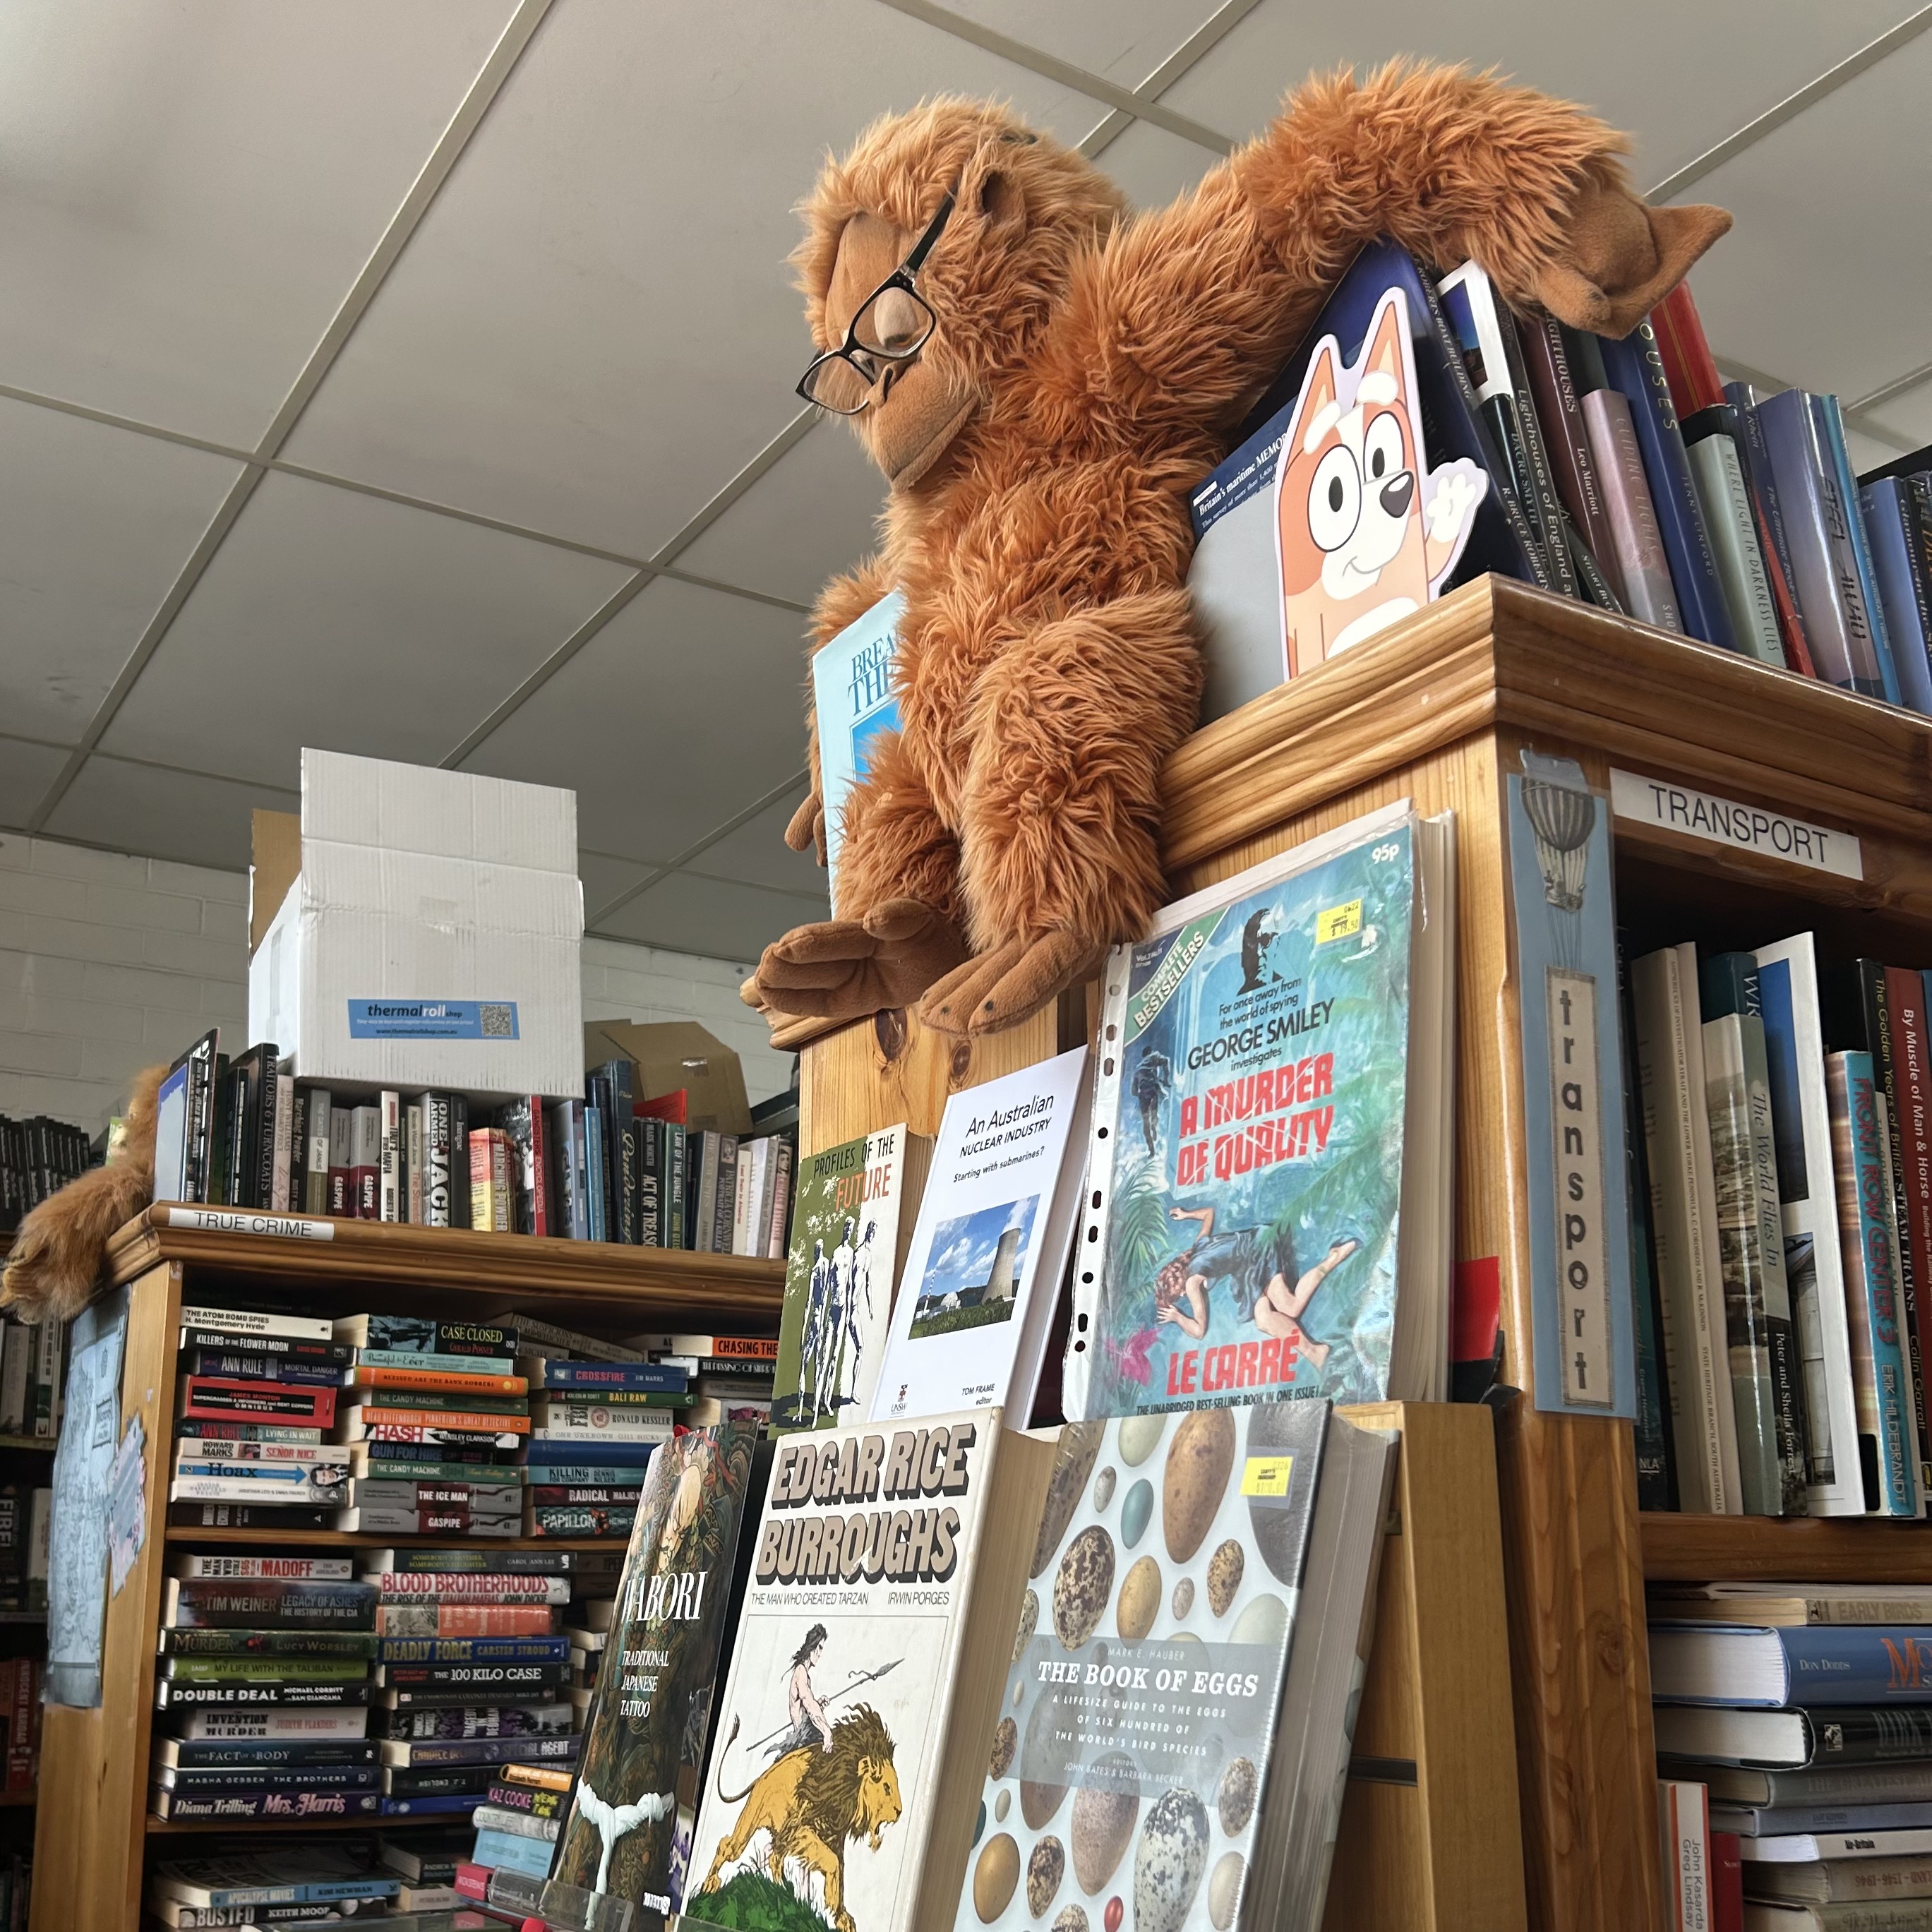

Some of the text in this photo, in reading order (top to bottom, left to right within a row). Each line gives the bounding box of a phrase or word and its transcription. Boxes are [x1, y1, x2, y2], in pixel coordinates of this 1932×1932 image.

[1199, 487, 1225, 516] Britain's
[1226, 463, 1255, 493] maritime
[1518, 389, 1571, 584] Lighthouses of England
[1726, 453, 1780, 652] WHERE LIGHT IN DARKNESS LIES
[852, 632, 898, 683] BREA
[1648, 784, 1829, 864] TRANSPORT
[1372, 843, 1400, 867] 95p
[1134, 930, 1204, 1029] BESTSELLERS
[1141, 941, 1184, 1000] COMPLETE
[368, 1004, 445, 1016] thermalroll
[1219, 978, 1302, 1017] For once away from
[1220, 994, 1299, 1031] the world of spying
[1187, 997, 1336, 1072] GEORGE SMILEY
[1230, 1046, 1282, 1072] investigates
[265, 1055, 276, 1108] TRAITORS
[1179, 1052, 1334, 1140] A MURDER
[966, 1093, 1055, 1138] An Australian
[1903, 1009, 1929, 1199] By Muscle of Man & Horse
[261, 1120, 274, 1192] TURNCOATS
[673, 1146, 682, 1156] OF
[959, 1117, 1052, 1158] NUCLEAR INDUSTRY
[1177, 1105, 1334, 1186] OF QUALITY
[1876, 979, 1916, 1312] The Golden Years of British STEAM TRAINS
[673, 1158, 682, 1175] THE
[814, 1133, 895, 1180] PROFILES OF THE
[954, 1146, 1045, 1184] Starting with submarines?
[673, 1175, 682, 1204] JUNGLE
[836, 1163, 892, 1212] FUTURE
[1559, 988, 1589, 1391] transport
[1752, 1093, 1778, 1268] The World Flies In
[194, 1212, 313, 1237] TRUE CRIME
[643, 1175, 657, 1248] ACT OF TREASO
[1853, 1076, 1895, 1343] FRONT ROW CENTER 3
[440, 1325, 503, 1343] CASE CLOSED
[221, 1356, 263, 1375] ANN RULE
[1166, 1328, 1300, 1396] LE CARRÉ
[1702, 1345, 1710, 1367] STATE
[575, 1370, 625, 1382] CROSSFIRE
[1704, 1369, 1713, 1406] HERITAGE
[608, 1392, 647, 1403] BALI RAW
[1776, 1333, 1796, 1474] Peter and Sheila Forrest
[375, 1425, 424, 1442] HASH
[1880, 1364, 1907, 1505] ERIK HILDEBRANDT
[771, 1422, 976, 1510] EDGAR RICE
[1639, 1457, 1659, 1471] NLA
[1710, 1442, 1718, 1466] SOUTH
[419, 1490, 433, 1500] THE
[436, 1491, 450, 1501] ICE
[450, 1492, 468, 1501] MAN
[569, 1489, 610, 1502] RADICAL
[1711, 1468, 1722, 1511] AUSTRALIA
[755, 1506, 961, 1588] BURROUGHS
[260, 1560, 314, 1578] MADOFF
[382, 1573, 549, 1595] BLOOD BROTHERHOODS
[752, 1592, 949, 1604] THE MAN WHO CREATED TARZAN IRWIN PORGES
[1837, 1601, 1921, 1620] EARLY BIRDS
[215, 1663, 335, 1674] MY LIFE WITH THE TALIBAN
[383, 1640, 473, 1661] DEADLY FORCE
[621, 1650, 669, 1667] TRADITIONAL
[1108, 1646, 1185, 1662] MARK E. HAUBER
[173, 1688, 279, 1701] DOUBLE DEAL
[621, 1674, 659, 1693] JAPANESE
[1037, 1660, 1259, 1698] THE BOOK OF EGGS
[620, 1700, 650, 1719] TATTOO
[1052, 1695, 1226, 1719] A LIFESIZE GUIDE TO THE EGGS
[1077, 1715, 1190, 1734] OF SIX HUNDRED OF
[1055, 1731, 1208, 1756] THE WORLD'S BIRD SPECIES
[488, 1787, 532, 1808] KAZ COOKE
[1844, 1838, 1876, 1849] Air-Britain
[1682, 1838, 1695, 1927] Greg Lindsay
[1691, 1838, 1703, 1931] John Kasarda
